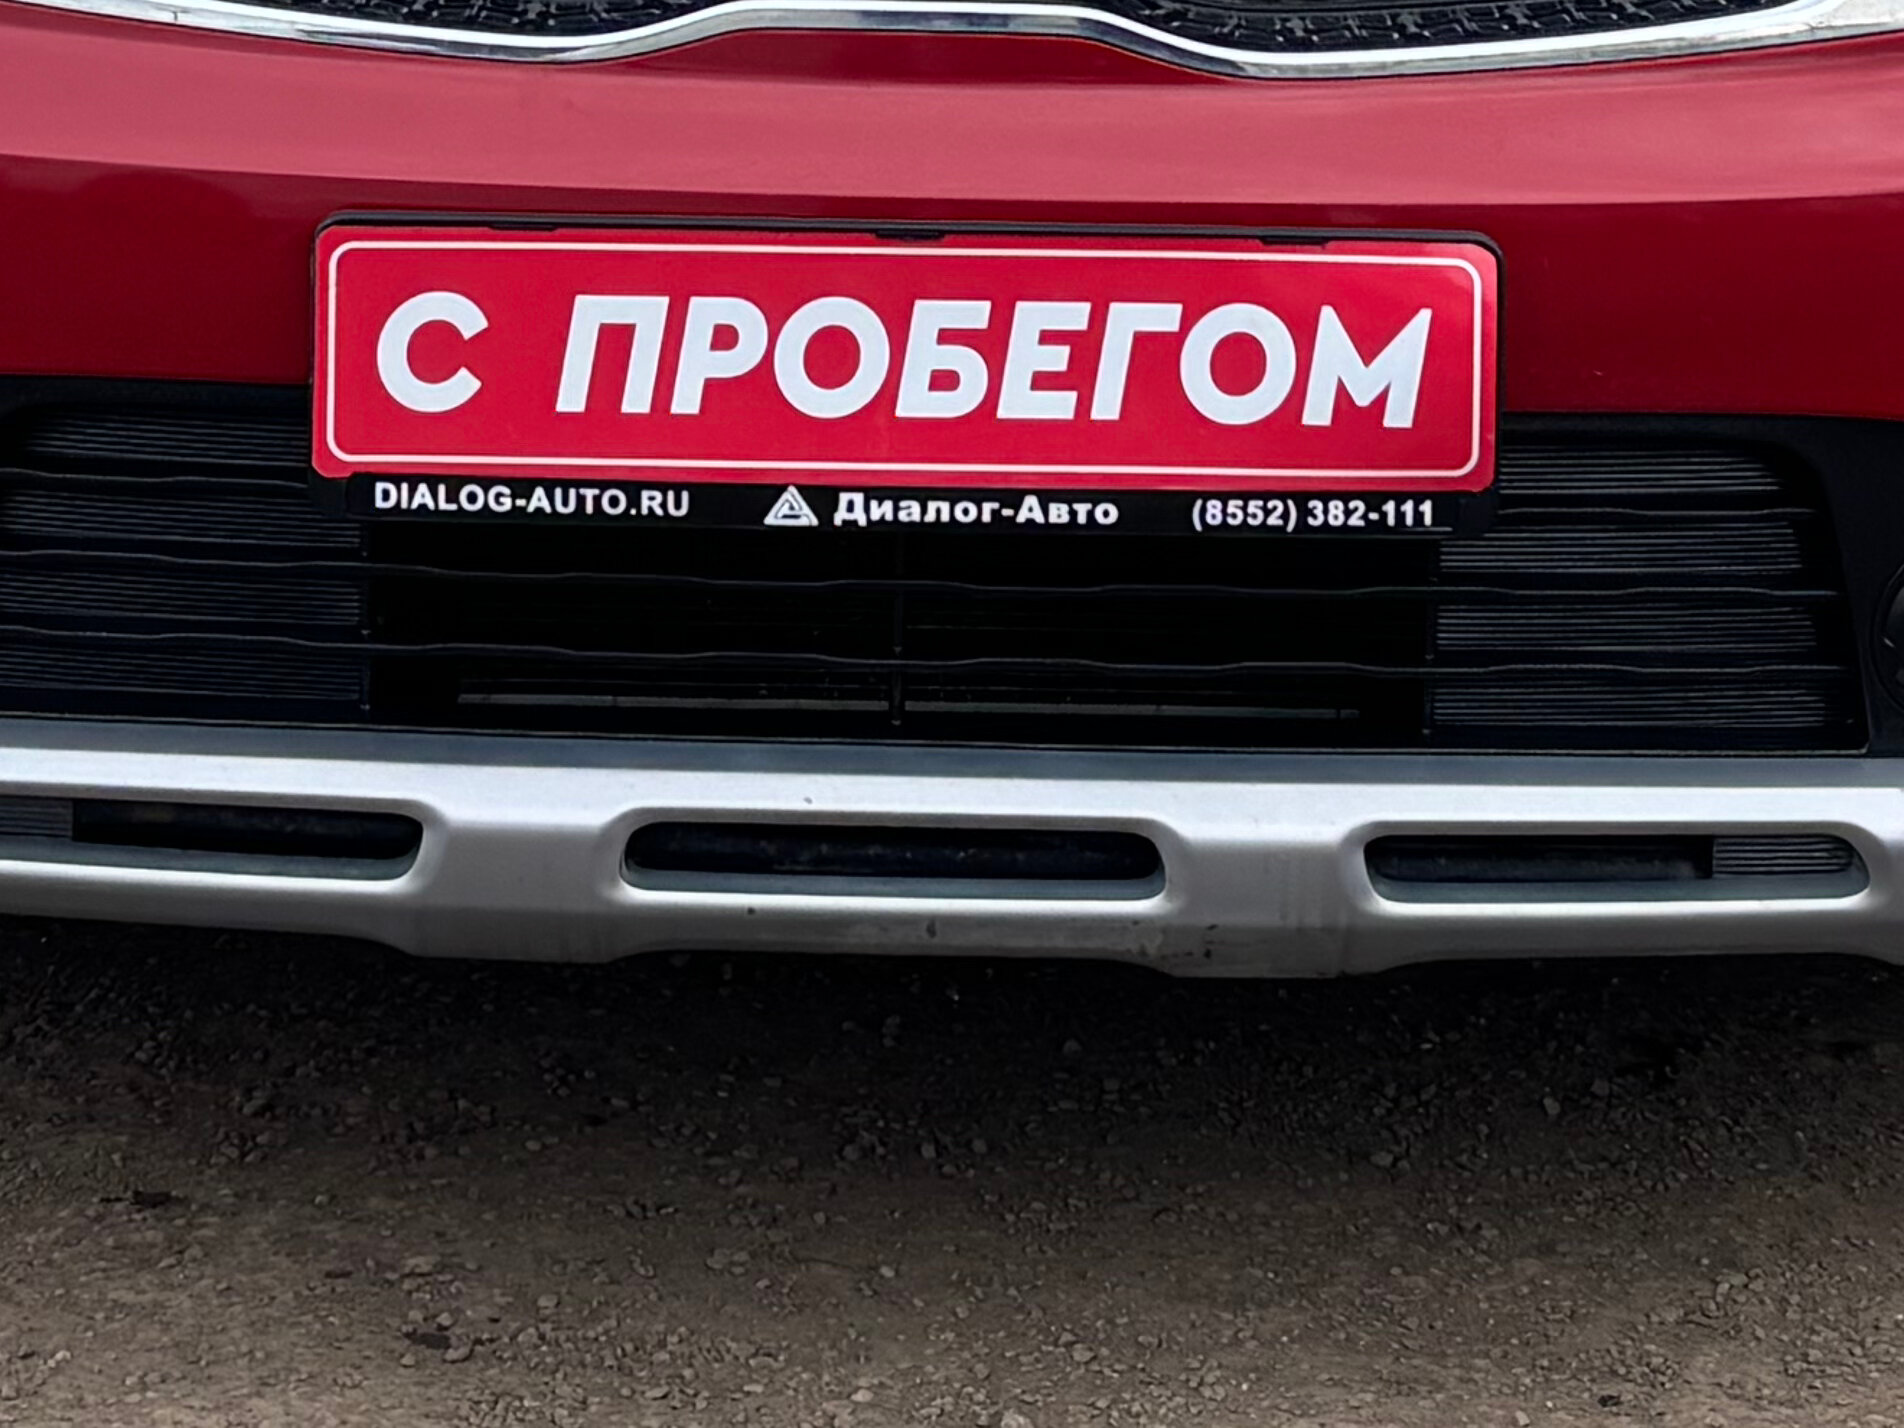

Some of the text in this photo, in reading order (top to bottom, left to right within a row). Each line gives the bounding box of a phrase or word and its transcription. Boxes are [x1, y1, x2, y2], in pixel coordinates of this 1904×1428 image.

[376, 290, 1433, 429] С ПРОБЕГОМ
[374, 481, 691, 517] DIALOG-AUTO.RU
[832, 491, 1120, 527] Диалог-Авто
[1192, 498, 1434, 533] (8552) 382-111
